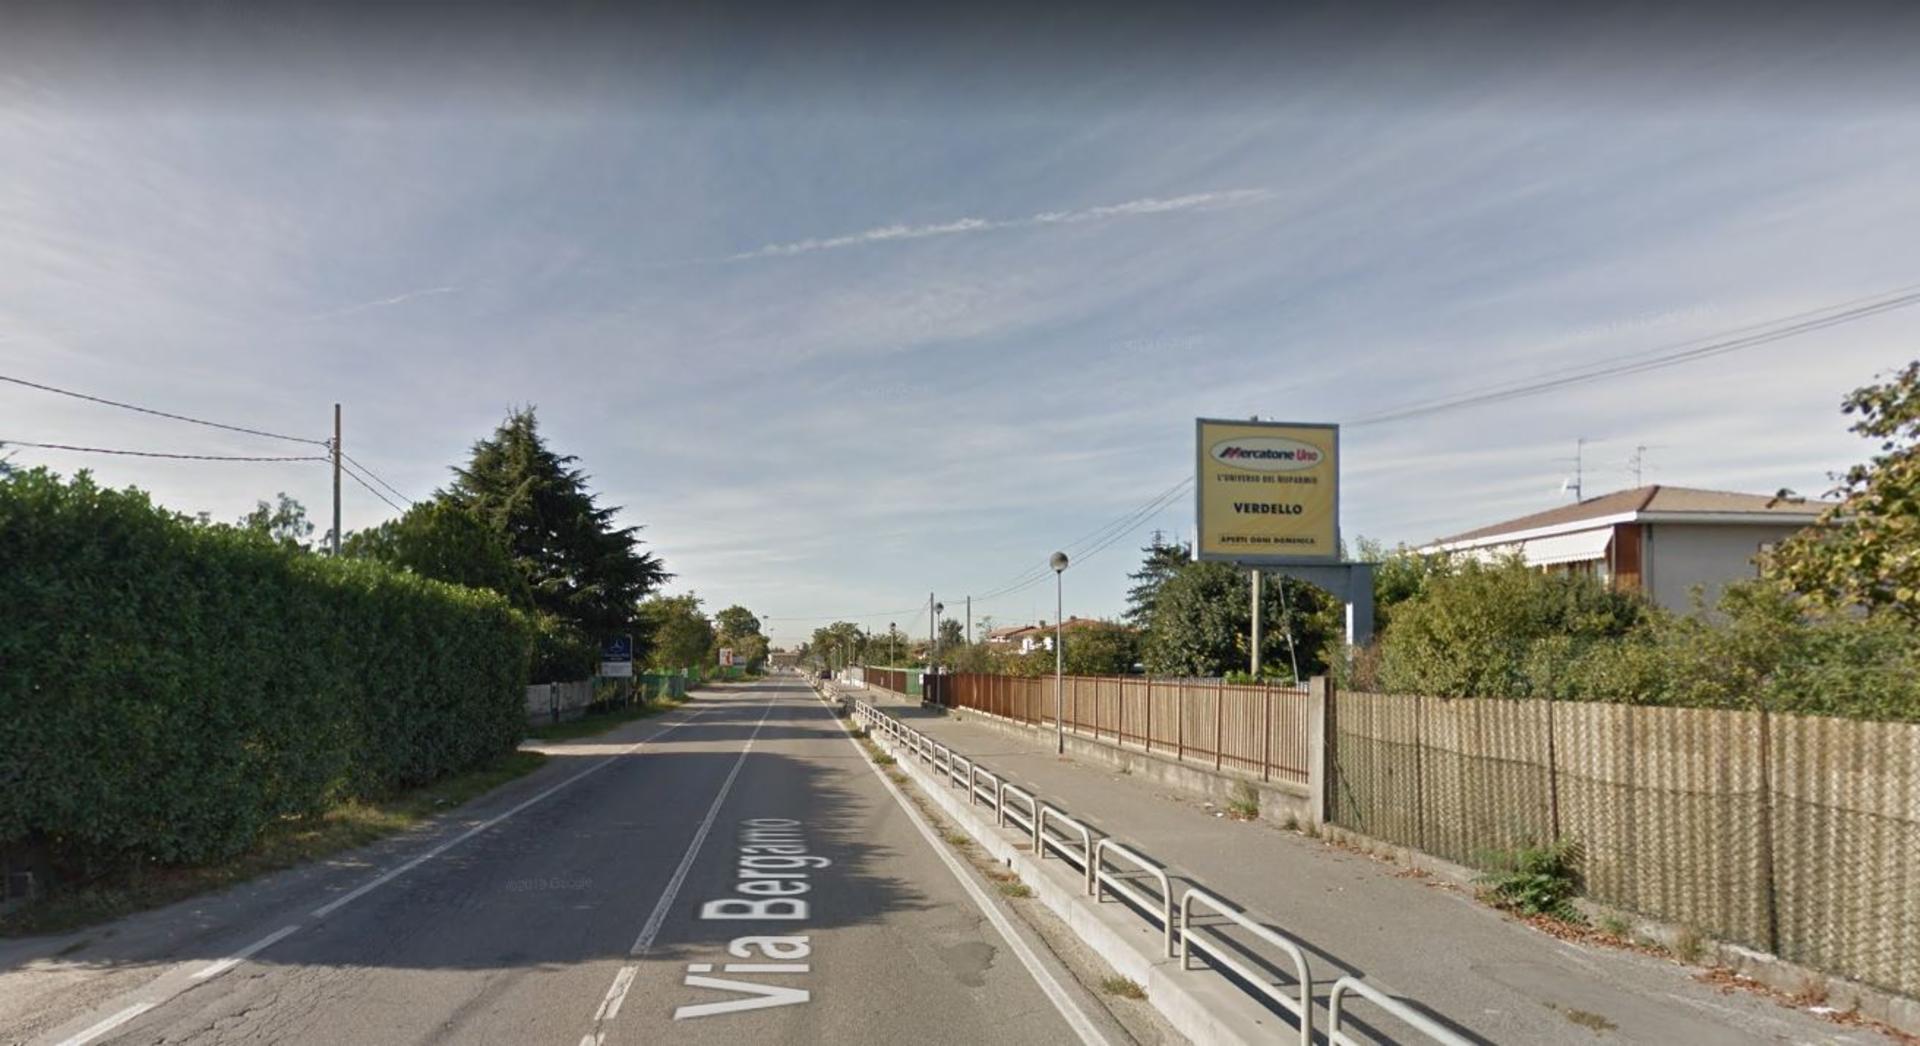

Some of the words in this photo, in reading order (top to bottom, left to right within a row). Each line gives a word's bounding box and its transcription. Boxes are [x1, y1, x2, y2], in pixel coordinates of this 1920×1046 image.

[1219, 446, 1295, 460] Mercatone
[1296, 448, 1318, 461] Uno
[1217, 473, 1260, 483] L'UNIVERSO
[1262, 475, 1275, 483] DEL
[1277, 475, 1318, 484] RISPARMIO
[1234, 502, 1303, 514] VERDELLO
[1221, 535, 1248, 543] APERTI
[1250, 536, 1271, 544] OGNI
[1273, 536, 1315, 545] DOMENICA
